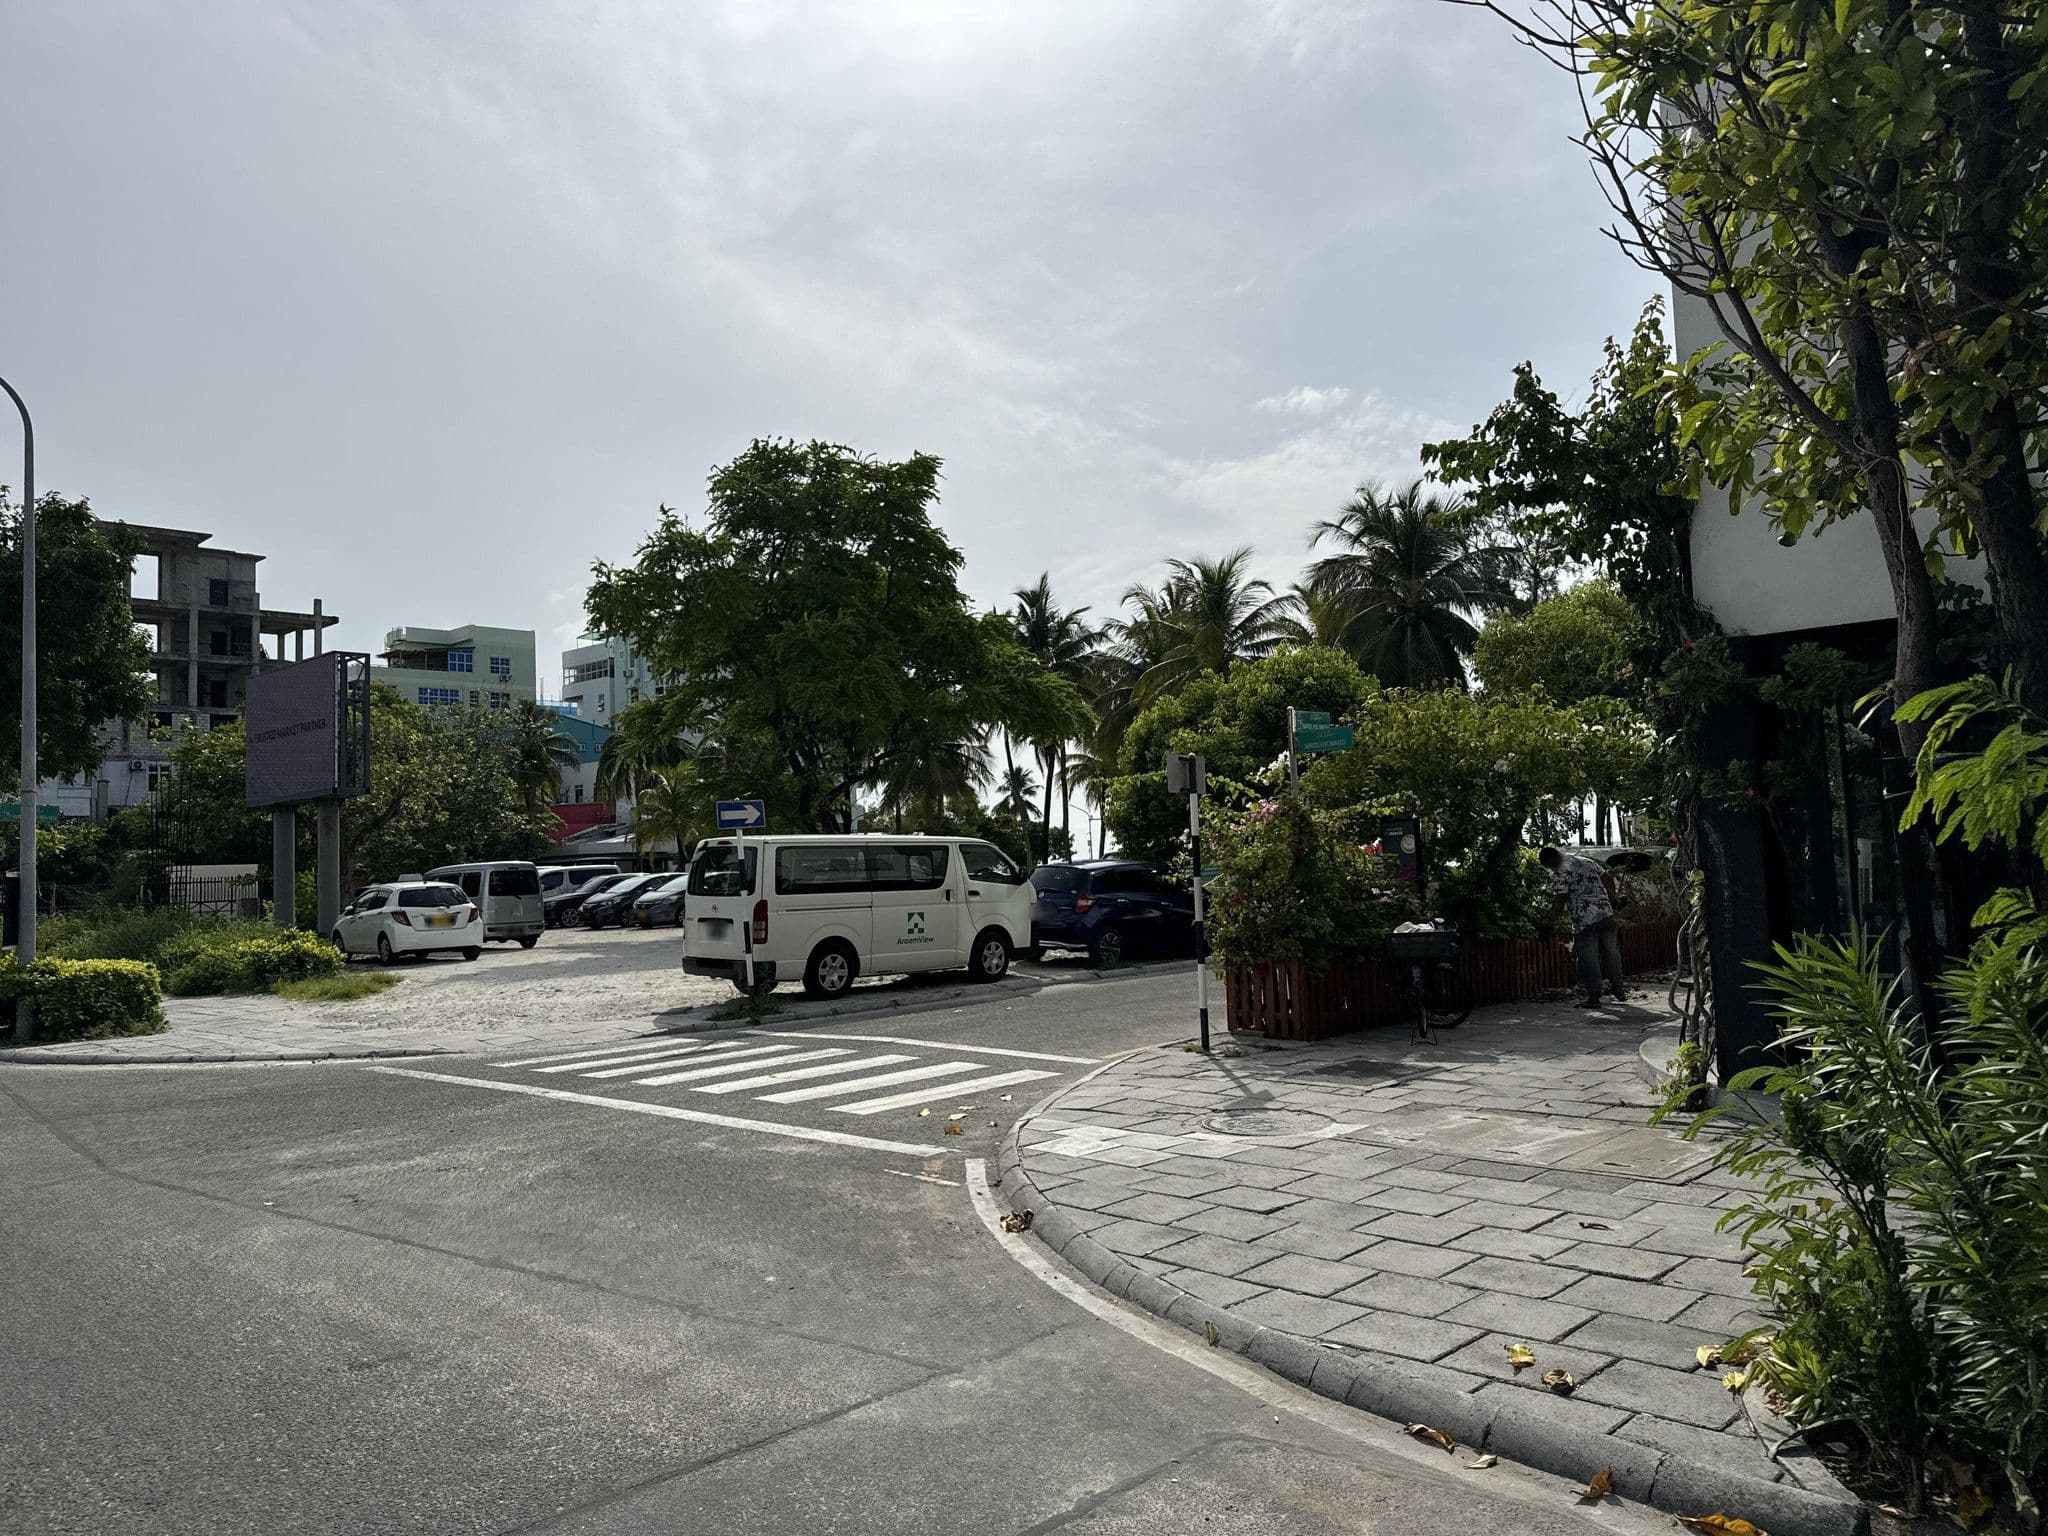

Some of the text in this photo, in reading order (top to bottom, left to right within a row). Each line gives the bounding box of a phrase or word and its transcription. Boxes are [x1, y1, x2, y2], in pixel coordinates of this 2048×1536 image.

[254, 729, 276, 743] TRUSTED
[277, 723, 300, 738] MARKET
[300, 718, 326, 734] PARTNER
